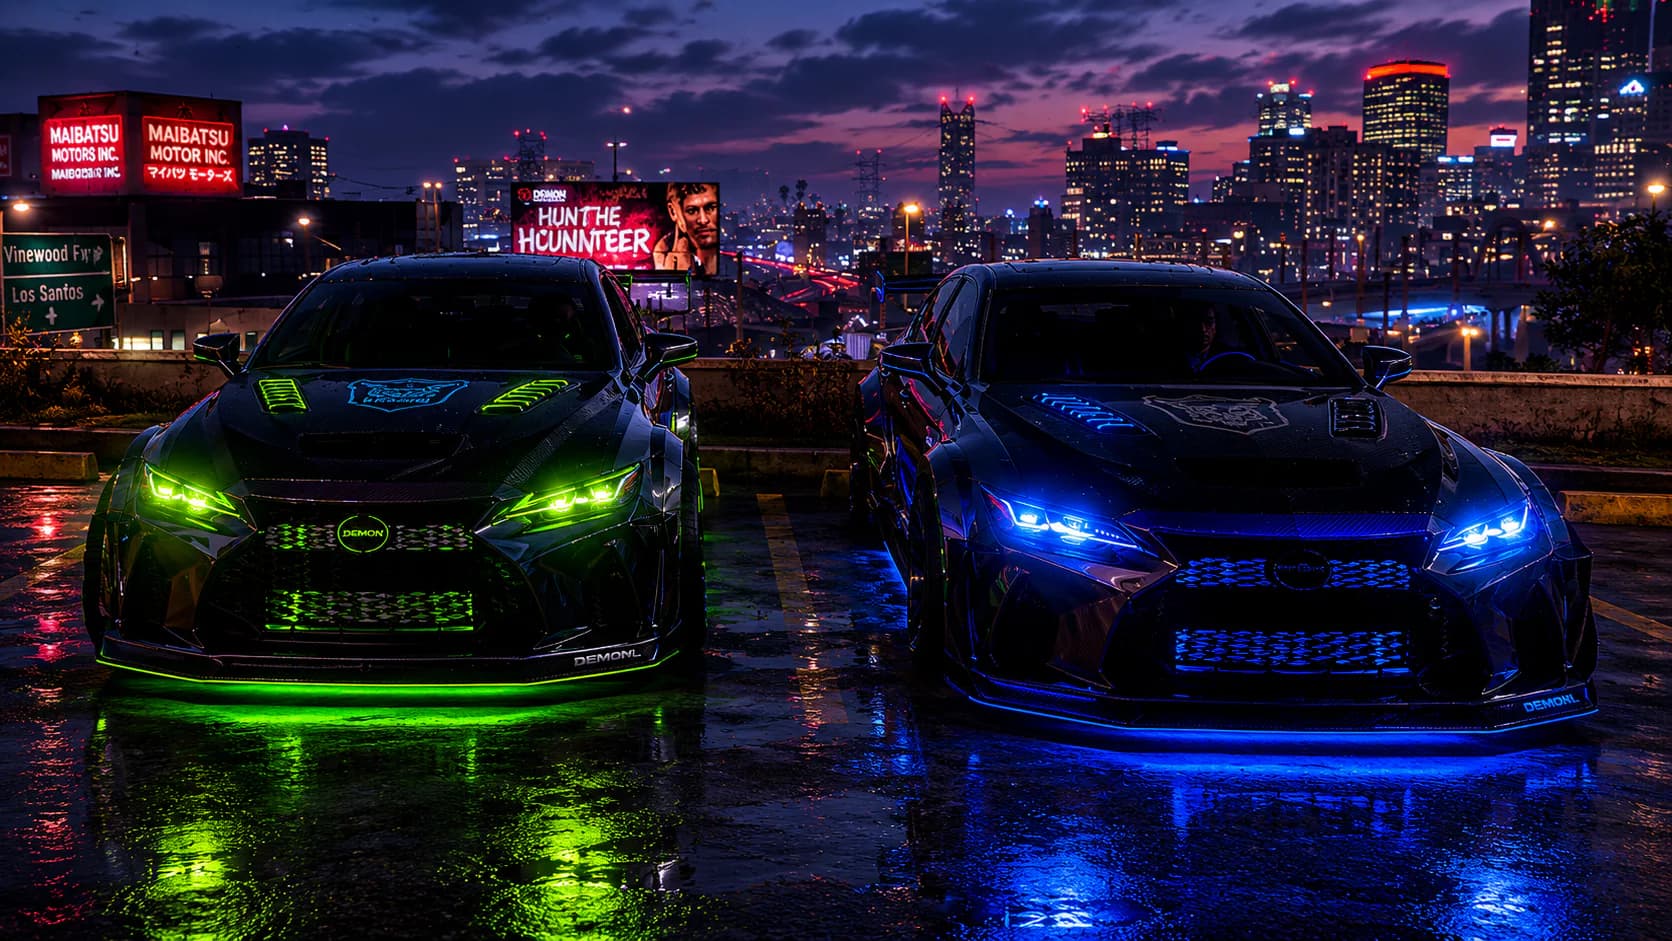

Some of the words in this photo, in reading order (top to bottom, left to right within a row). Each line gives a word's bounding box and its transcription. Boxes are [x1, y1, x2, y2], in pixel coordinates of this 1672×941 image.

[50, 124, 119, 144] MAIBATSU
[148, 124, 229, 146] MAIBATSU
[51, 147, 96, 162] MOTORS
[97, 146, 119, 161] INC.
[150, 145, 201, 163] MOTOR
[204, 148, 230, 165] INC.
[3, 244, 69, 264] Vinewood
[12, 286, 36, 304] Los
[39, 283, 84, 302] Santos
[343, 529, 384, 537] DEMON
